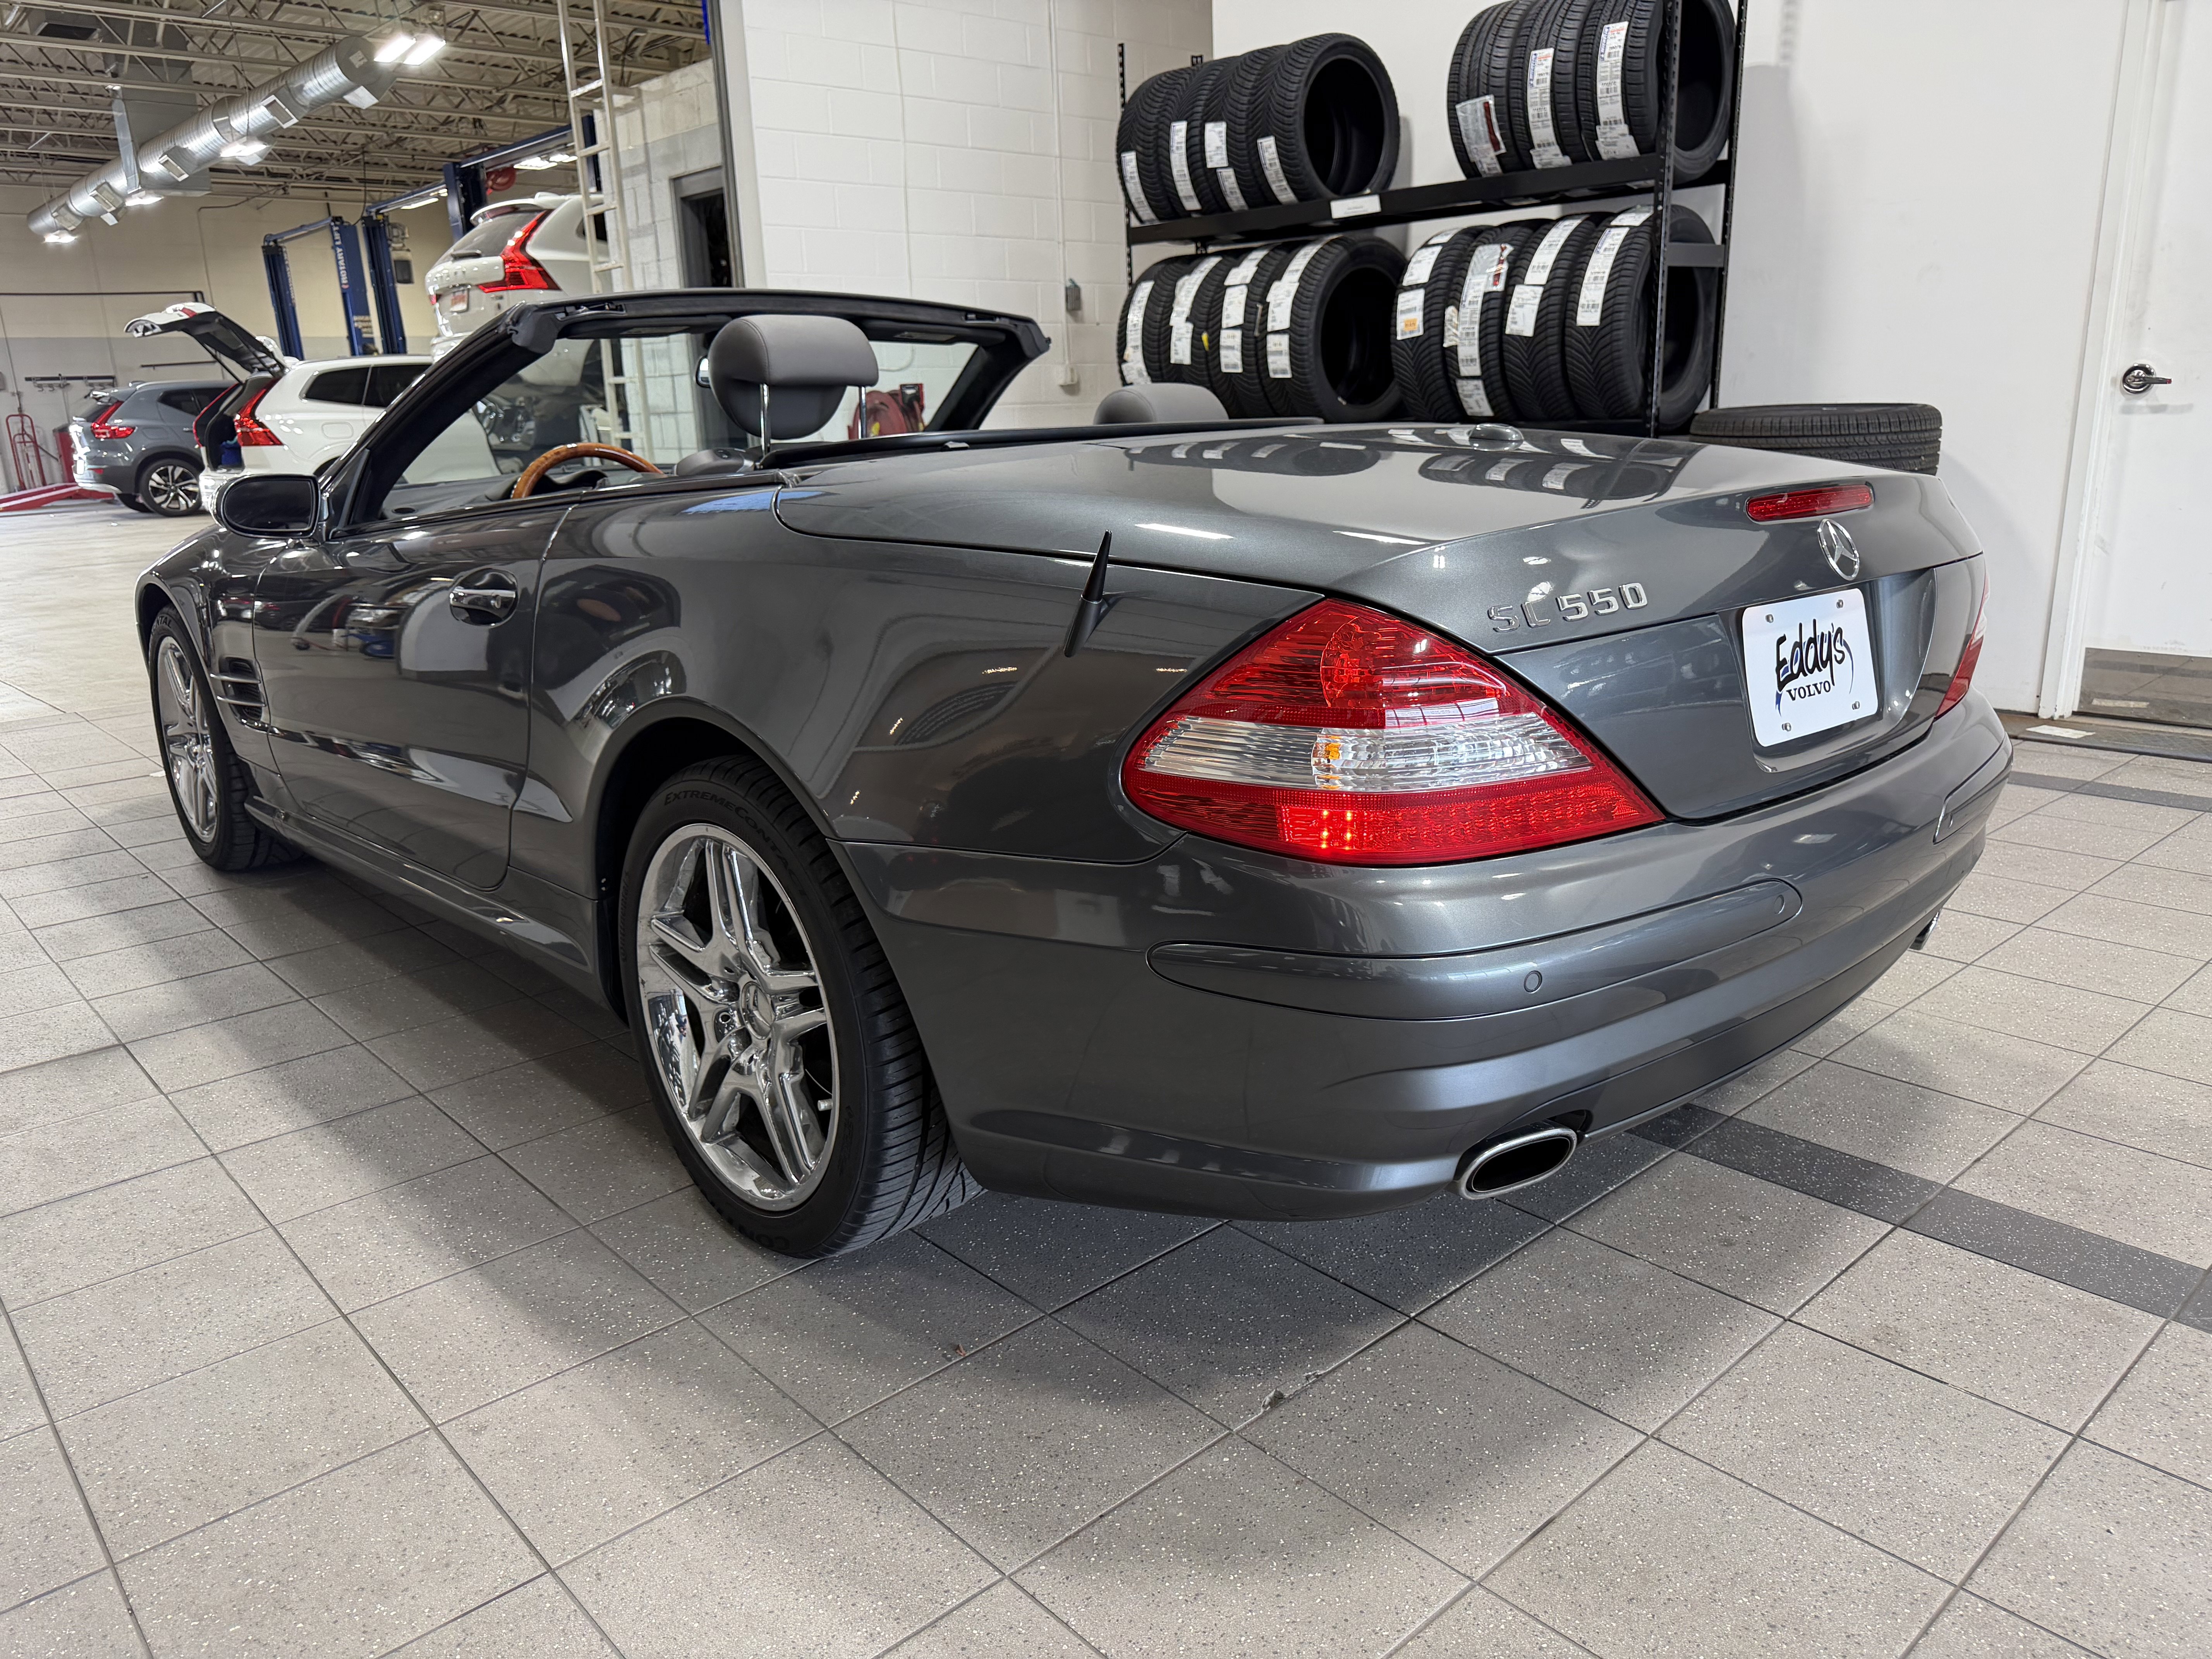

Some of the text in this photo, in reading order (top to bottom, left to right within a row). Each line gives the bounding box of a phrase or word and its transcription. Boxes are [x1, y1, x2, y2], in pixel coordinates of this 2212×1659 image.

[336, 246, 348, 284] ROTARY
[1555, 582, 1648, 622] 550
[1775, 618, 1845, 692] Eddy's
[1786, 680, 1831, 701] VOLVO
